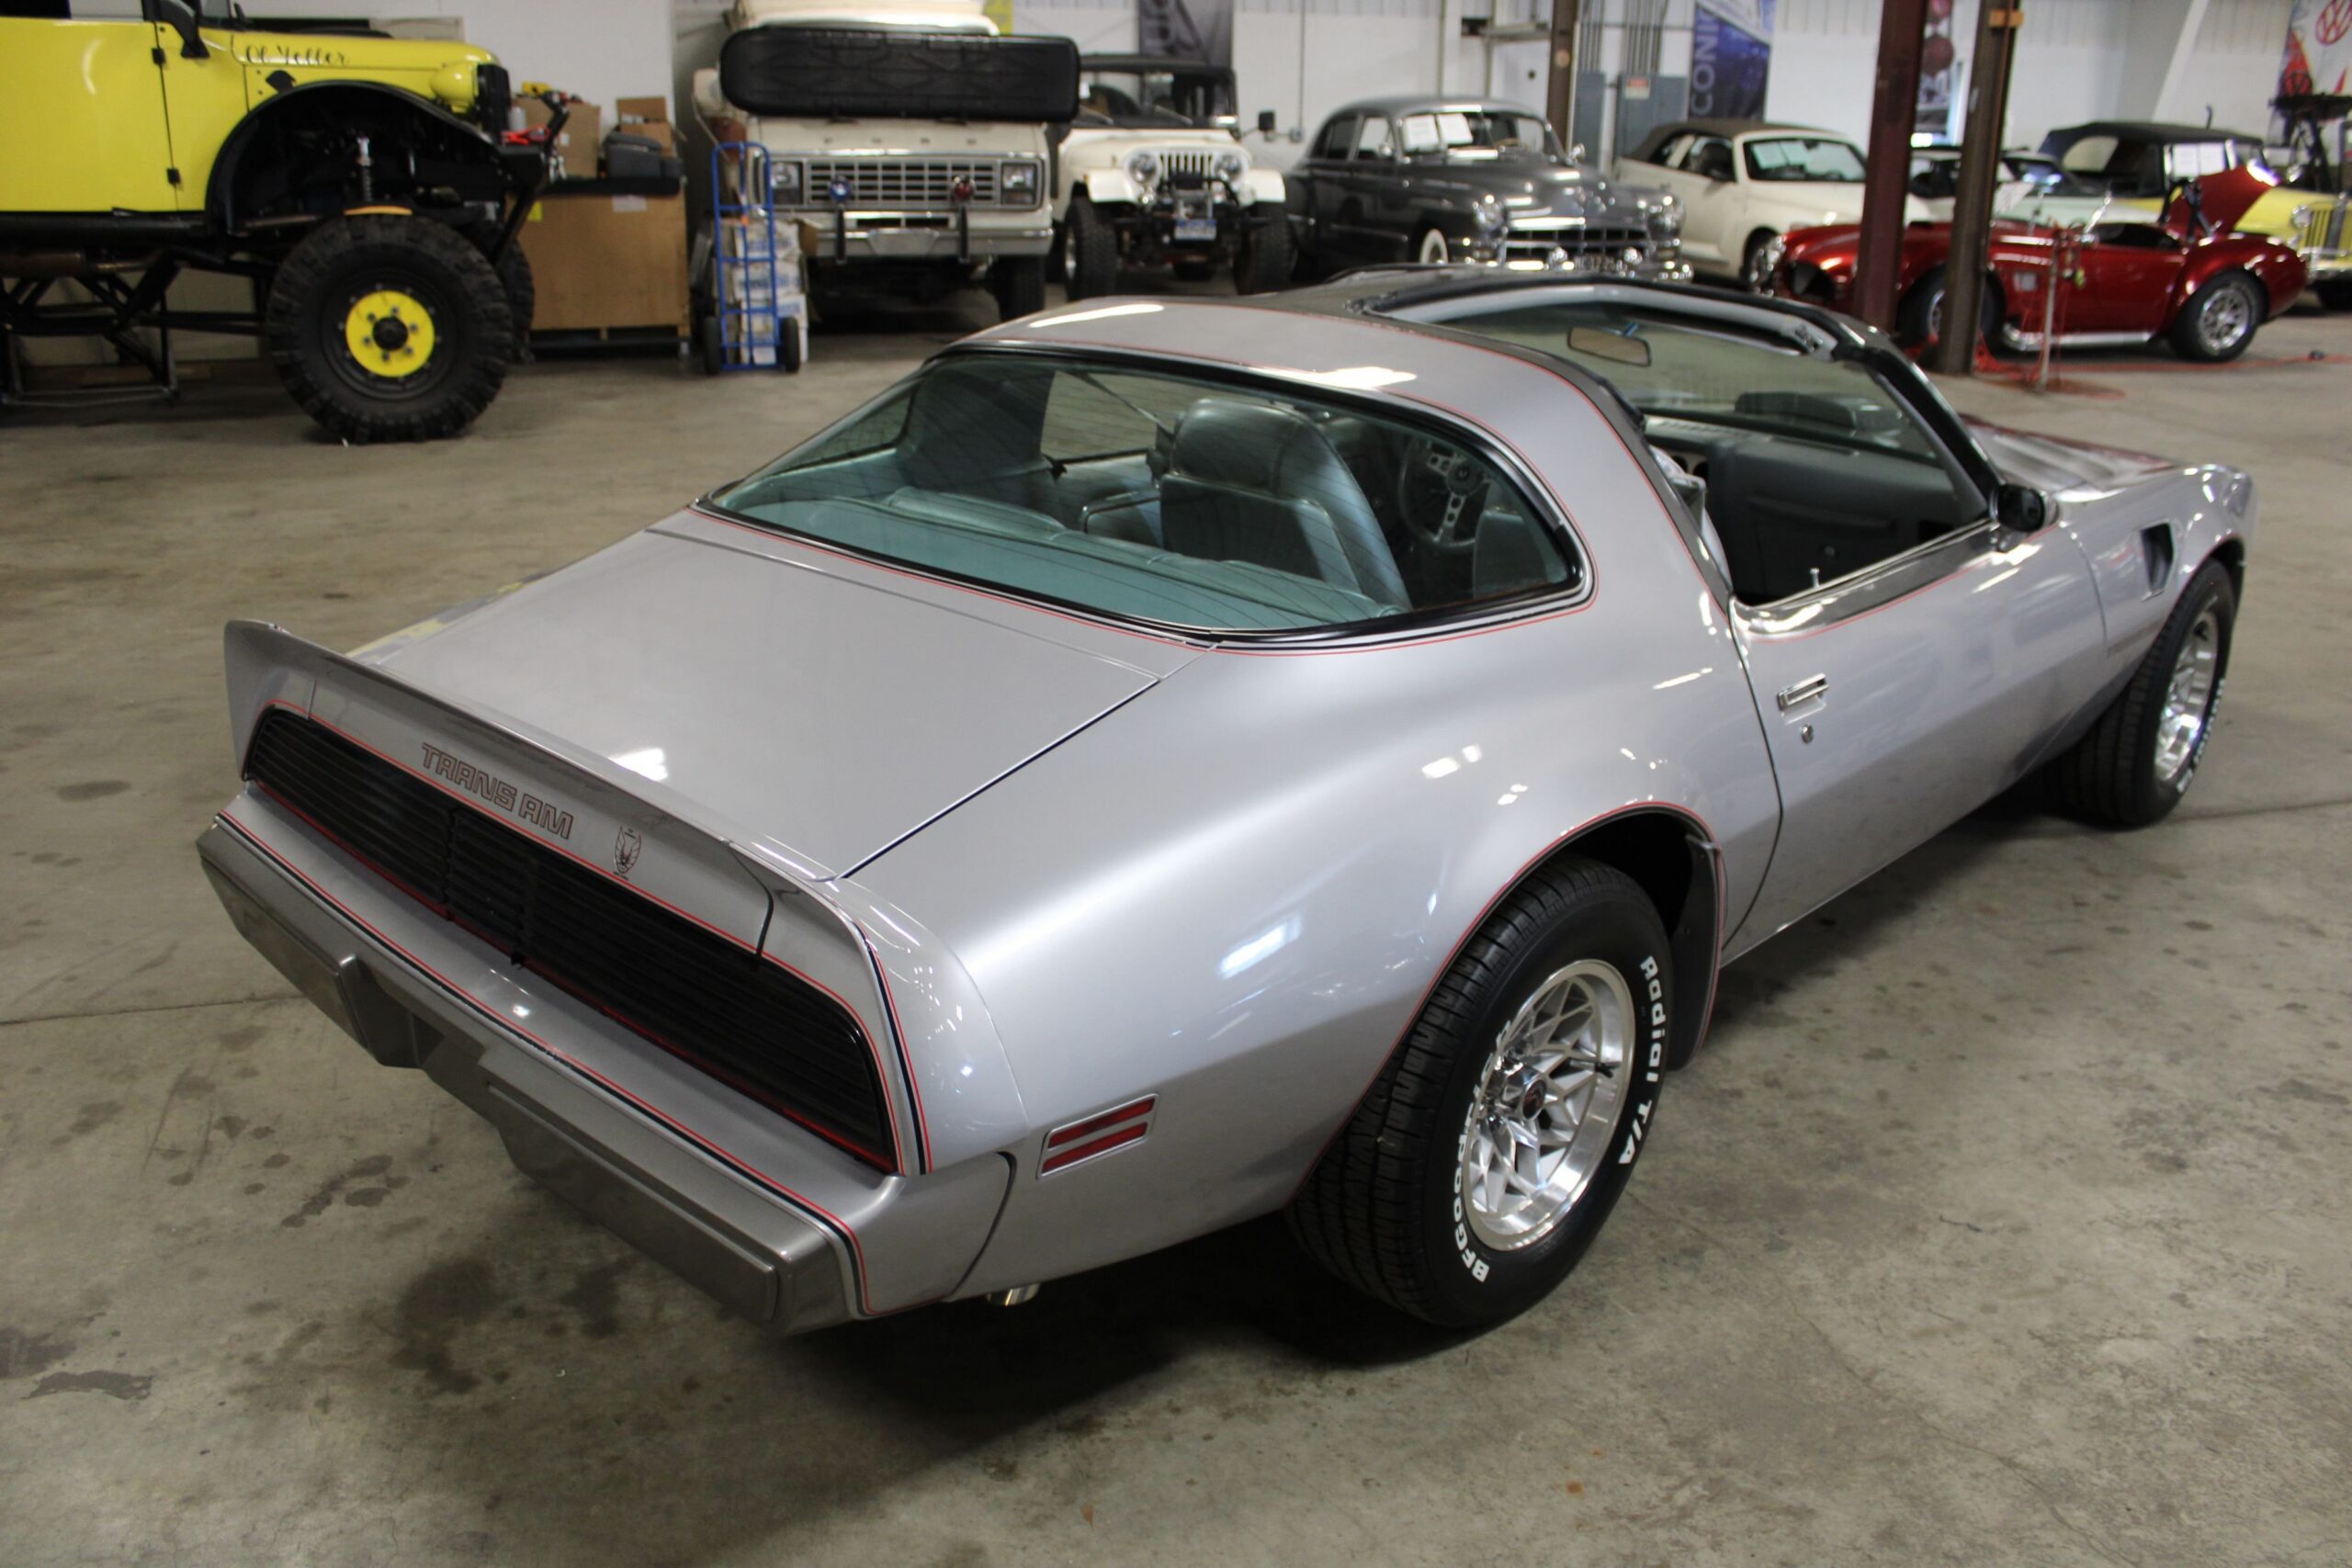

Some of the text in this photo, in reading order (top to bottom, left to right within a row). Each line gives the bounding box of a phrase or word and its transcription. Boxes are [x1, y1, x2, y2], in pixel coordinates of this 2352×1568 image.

[422, 742, 574, 840] TRANS AM
[1618, 955, 1667, 1164] Radial T/A
